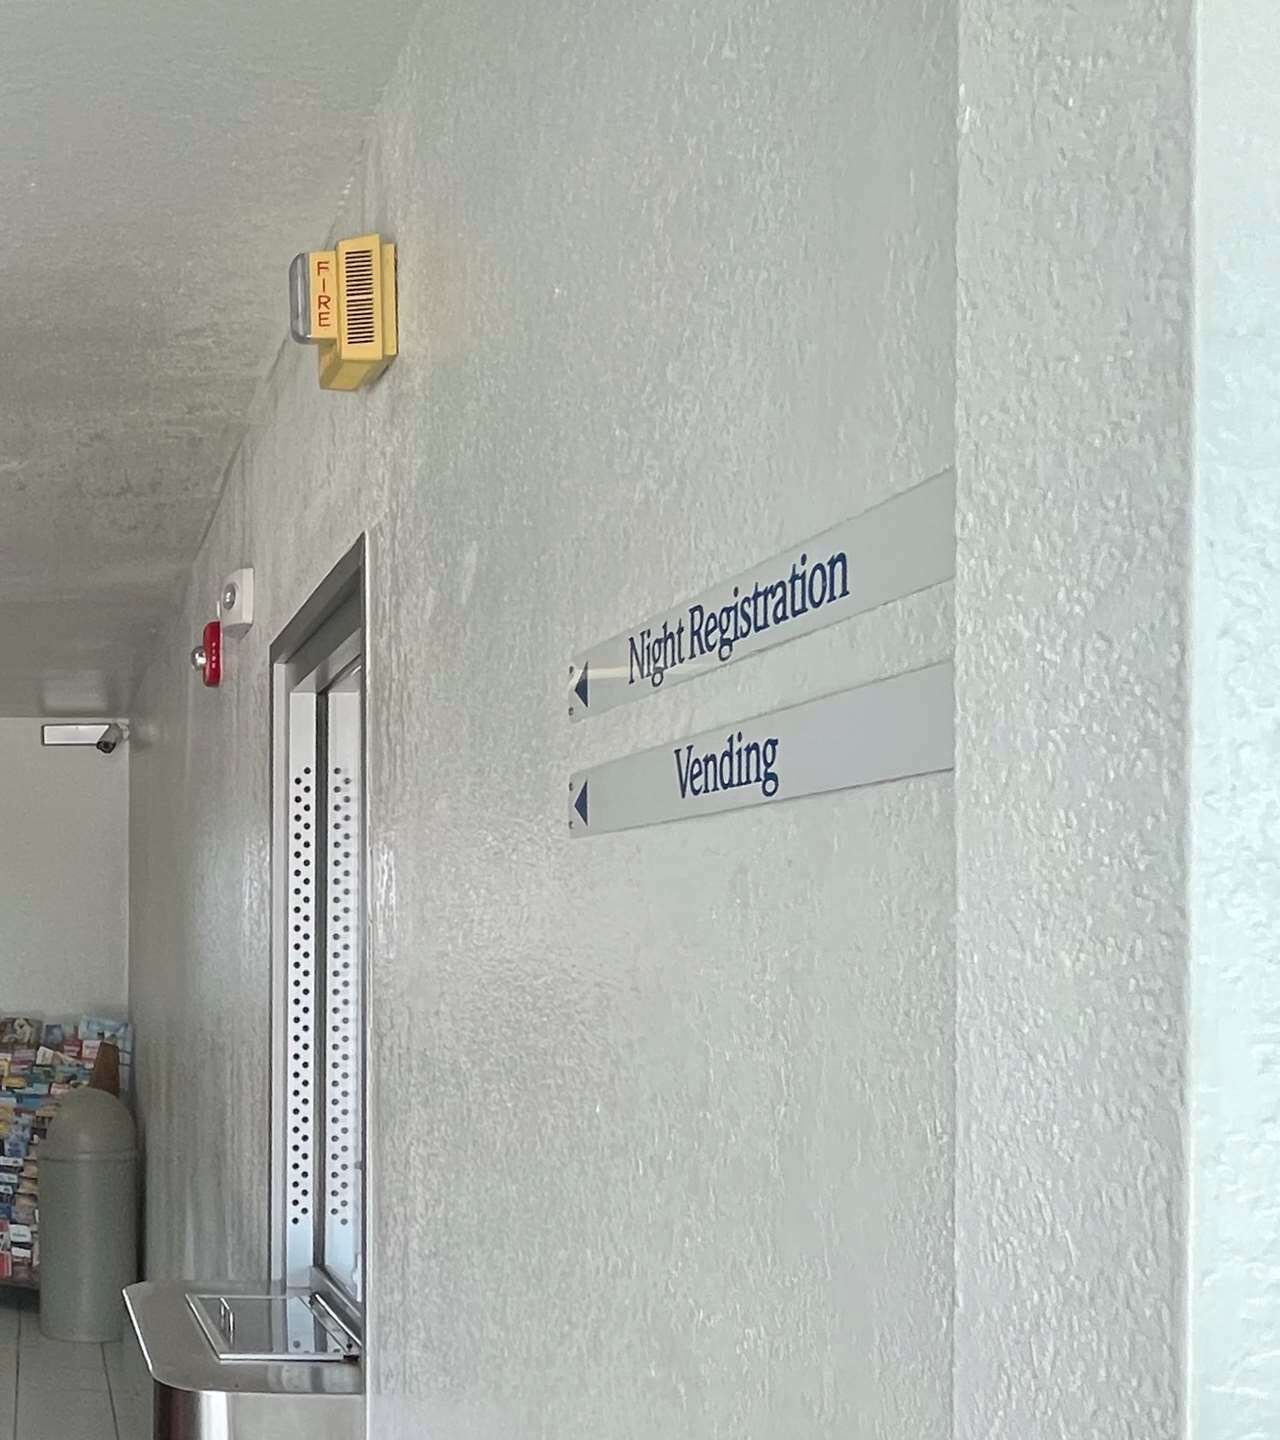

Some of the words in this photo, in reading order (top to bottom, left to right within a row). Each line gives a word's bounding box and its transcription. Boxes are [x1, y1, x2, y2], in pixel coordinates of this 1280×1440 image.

[316, 260, 331, 327] FIRE
[628, 617, 685, 688] Night
[688, 551, 851, 661] Registration
[673, 731, 780, 798] Vending
